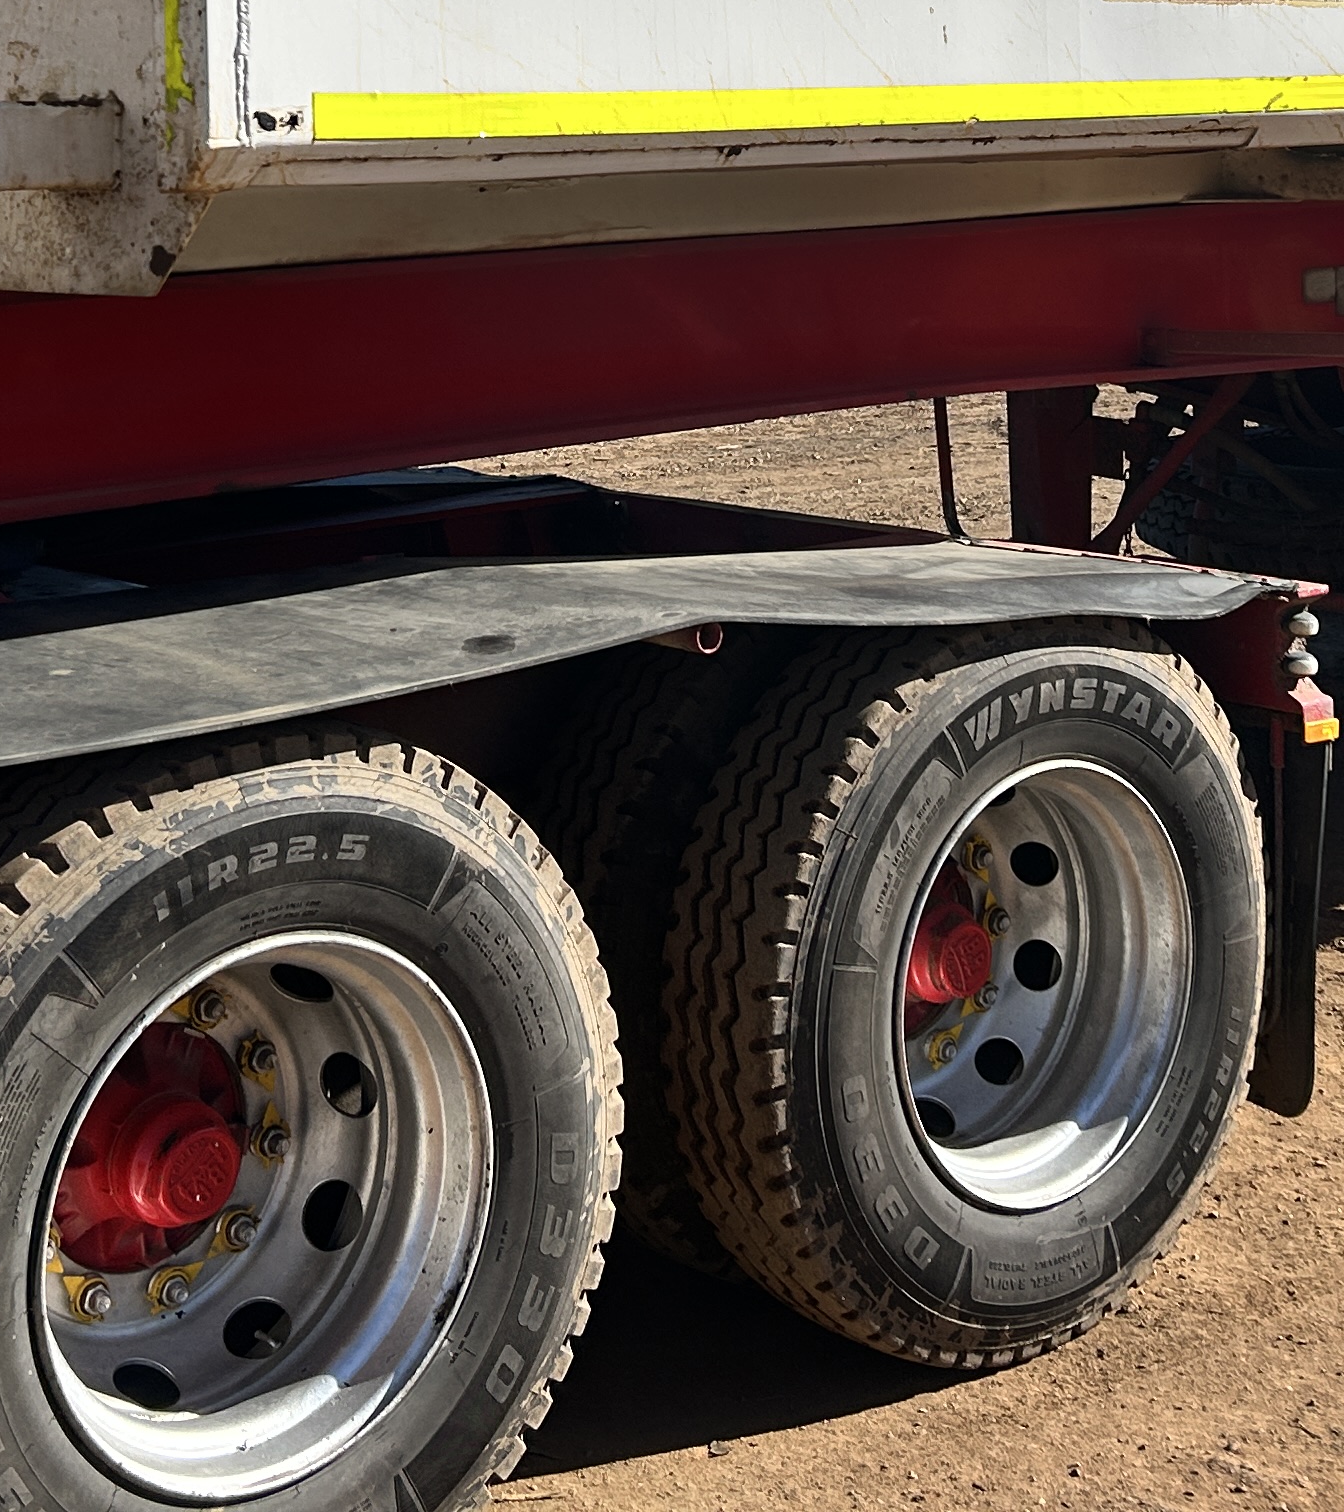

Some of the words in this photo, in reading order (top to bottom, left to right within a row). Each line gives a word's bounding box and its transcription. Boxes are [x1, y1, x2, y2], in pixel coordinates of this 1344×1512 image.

[963, 677, 1182, 751] WYNSTAR
[152, 833, 371, 922] 11R22.5
[842, 1074, 941, 1271] D330
[1166, 1005, 1244, 1198] 11R22.5
[485, 1132, 580, 1404] D330
